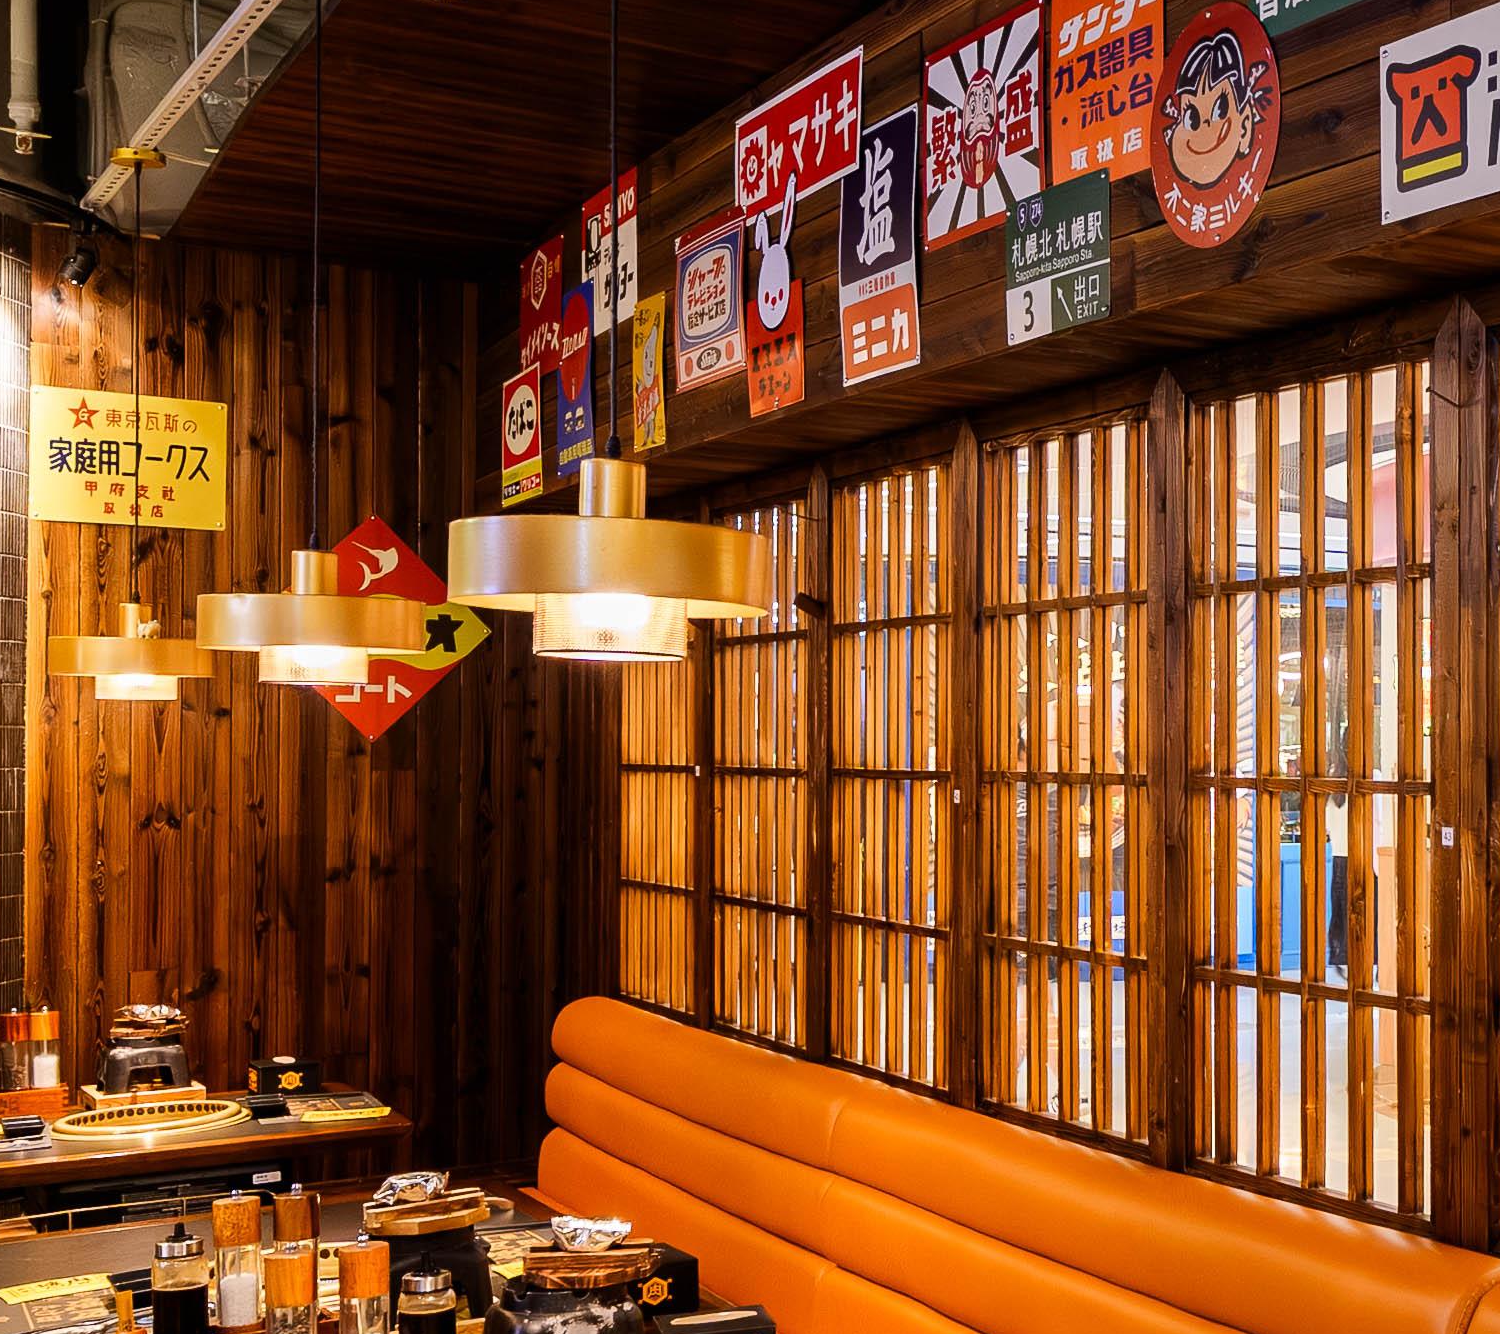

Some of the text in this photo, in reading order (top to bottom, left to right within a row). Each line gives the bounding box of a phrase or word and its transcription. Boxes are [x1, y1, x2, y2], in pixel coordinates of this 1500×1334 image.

[1053, 24, 1154, 99] ガス器具
[767, 79, 858, 189] ヤマサキ
[1070, 126, 1143, 170] 取扱店
[856, 138, 896, 266] 塩
[1012, 211, 1104, 269] 札幌北 札幌駅
[1052, 253, 1080, 269] Sapporo
[1073, 274, 1100, 304] 出口
[1077, 302, 1098, 319] EXIT
[1023, 290, 1034, 333] 3
[852, 308, 910, 365] ミニカ
[49, 437, 210, 482] 家庭用コークス
[84, 480, 176, 501] 甲府支社
